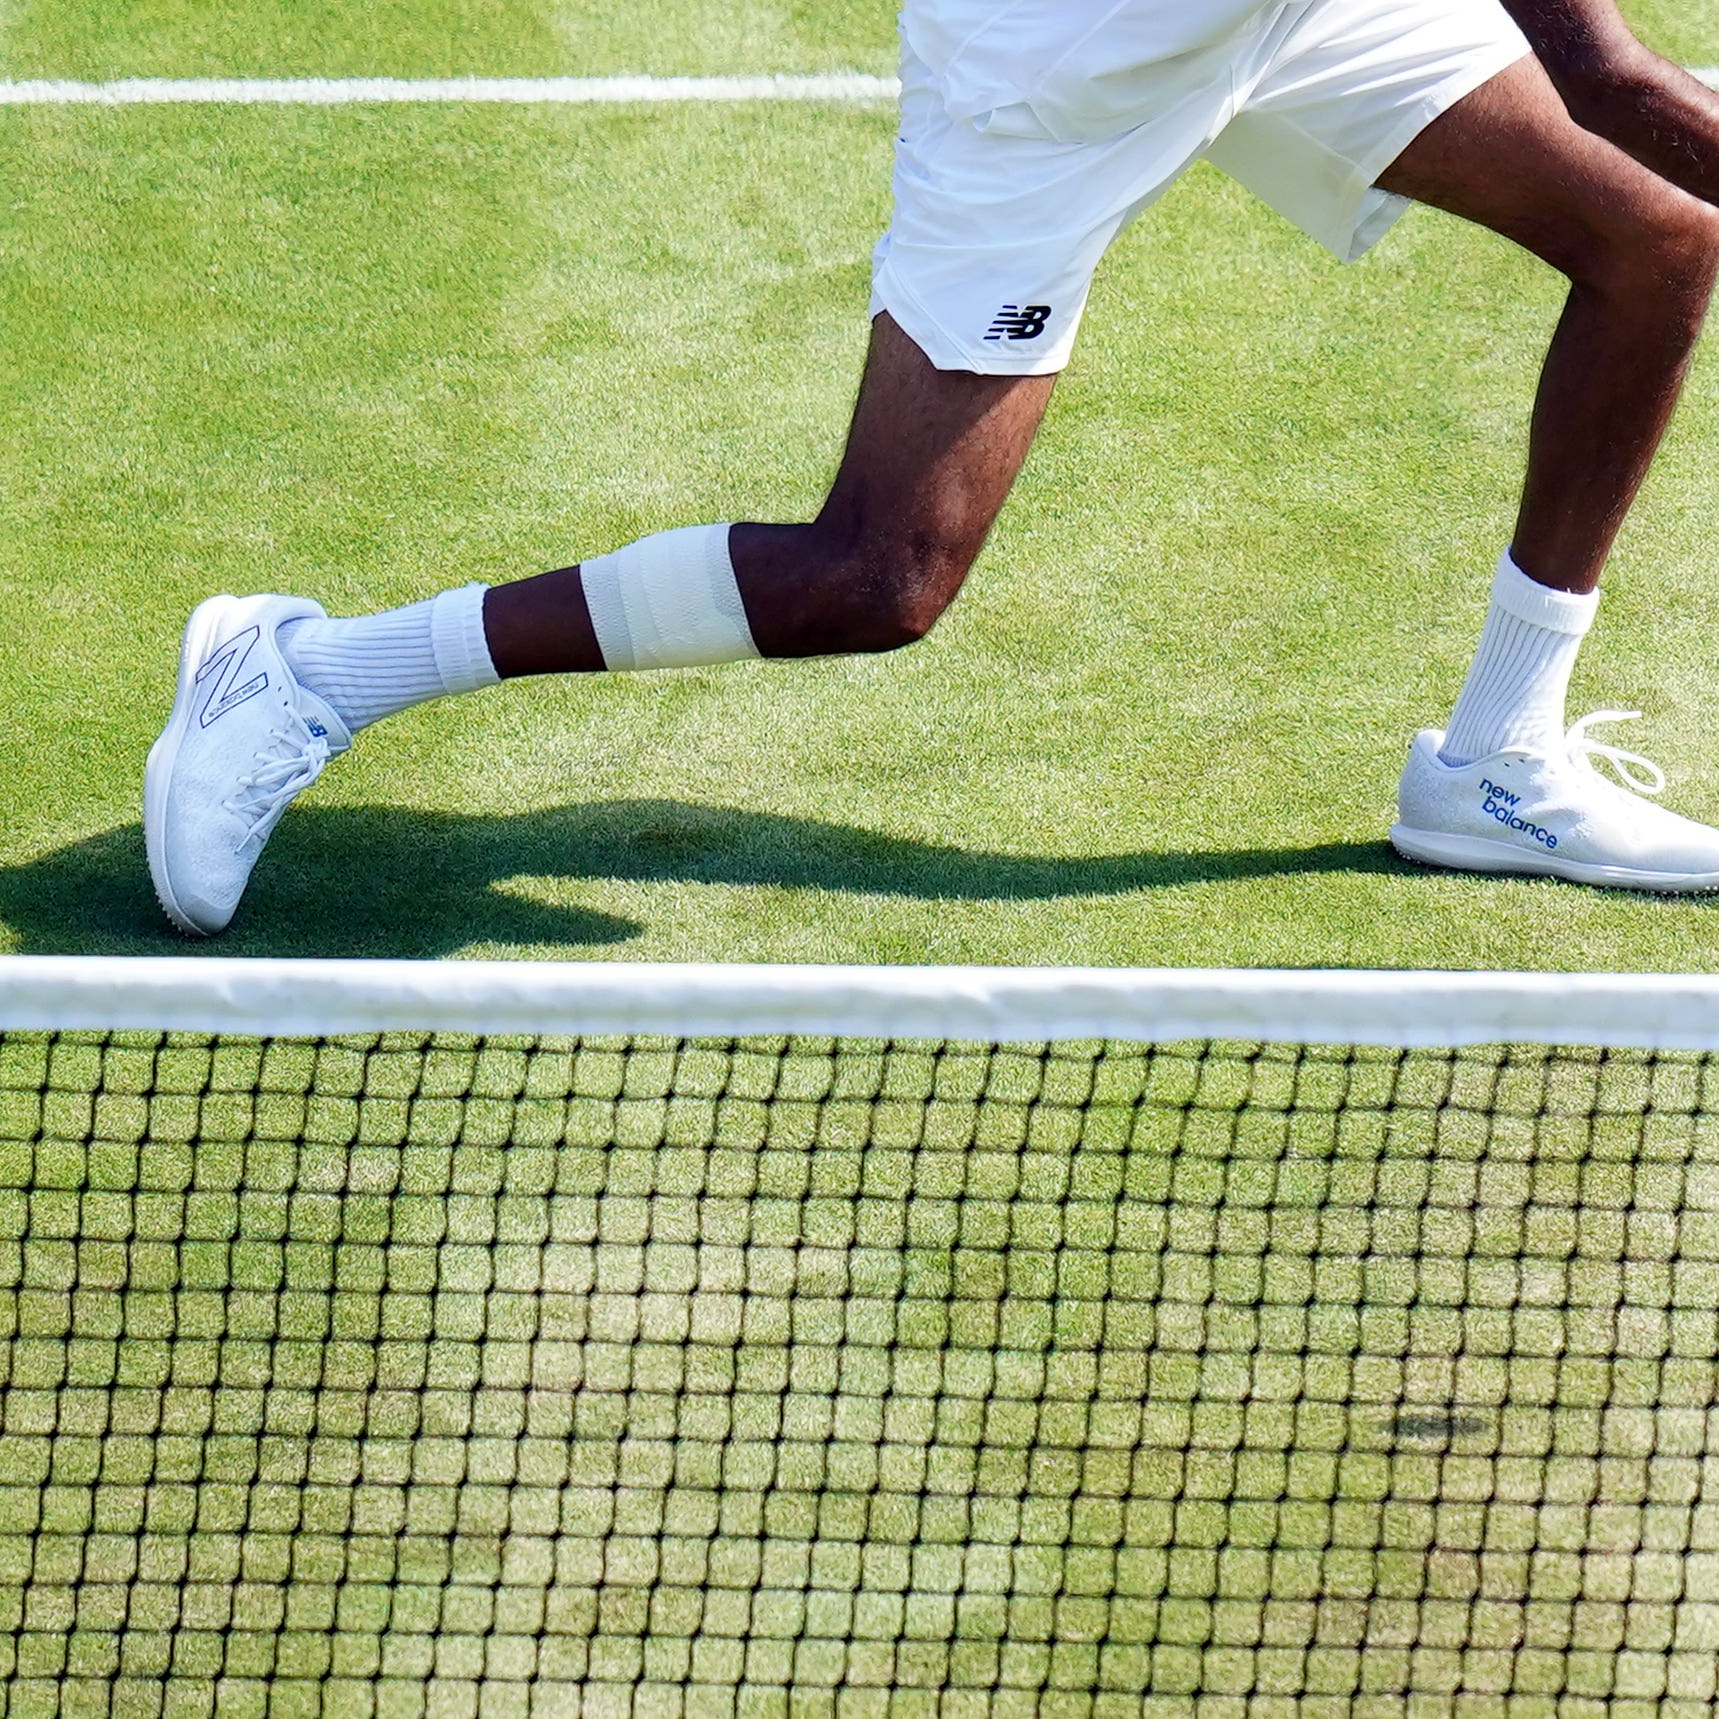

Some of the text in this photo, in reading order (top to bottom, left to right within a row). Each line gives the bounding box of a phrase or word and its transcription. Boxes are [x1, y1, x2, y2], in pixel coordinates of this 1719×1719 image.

[983, 305, 1052, 340] NB
[1479, 778, 1521, 807] new
[1481, 795, 1558, 849] balance
